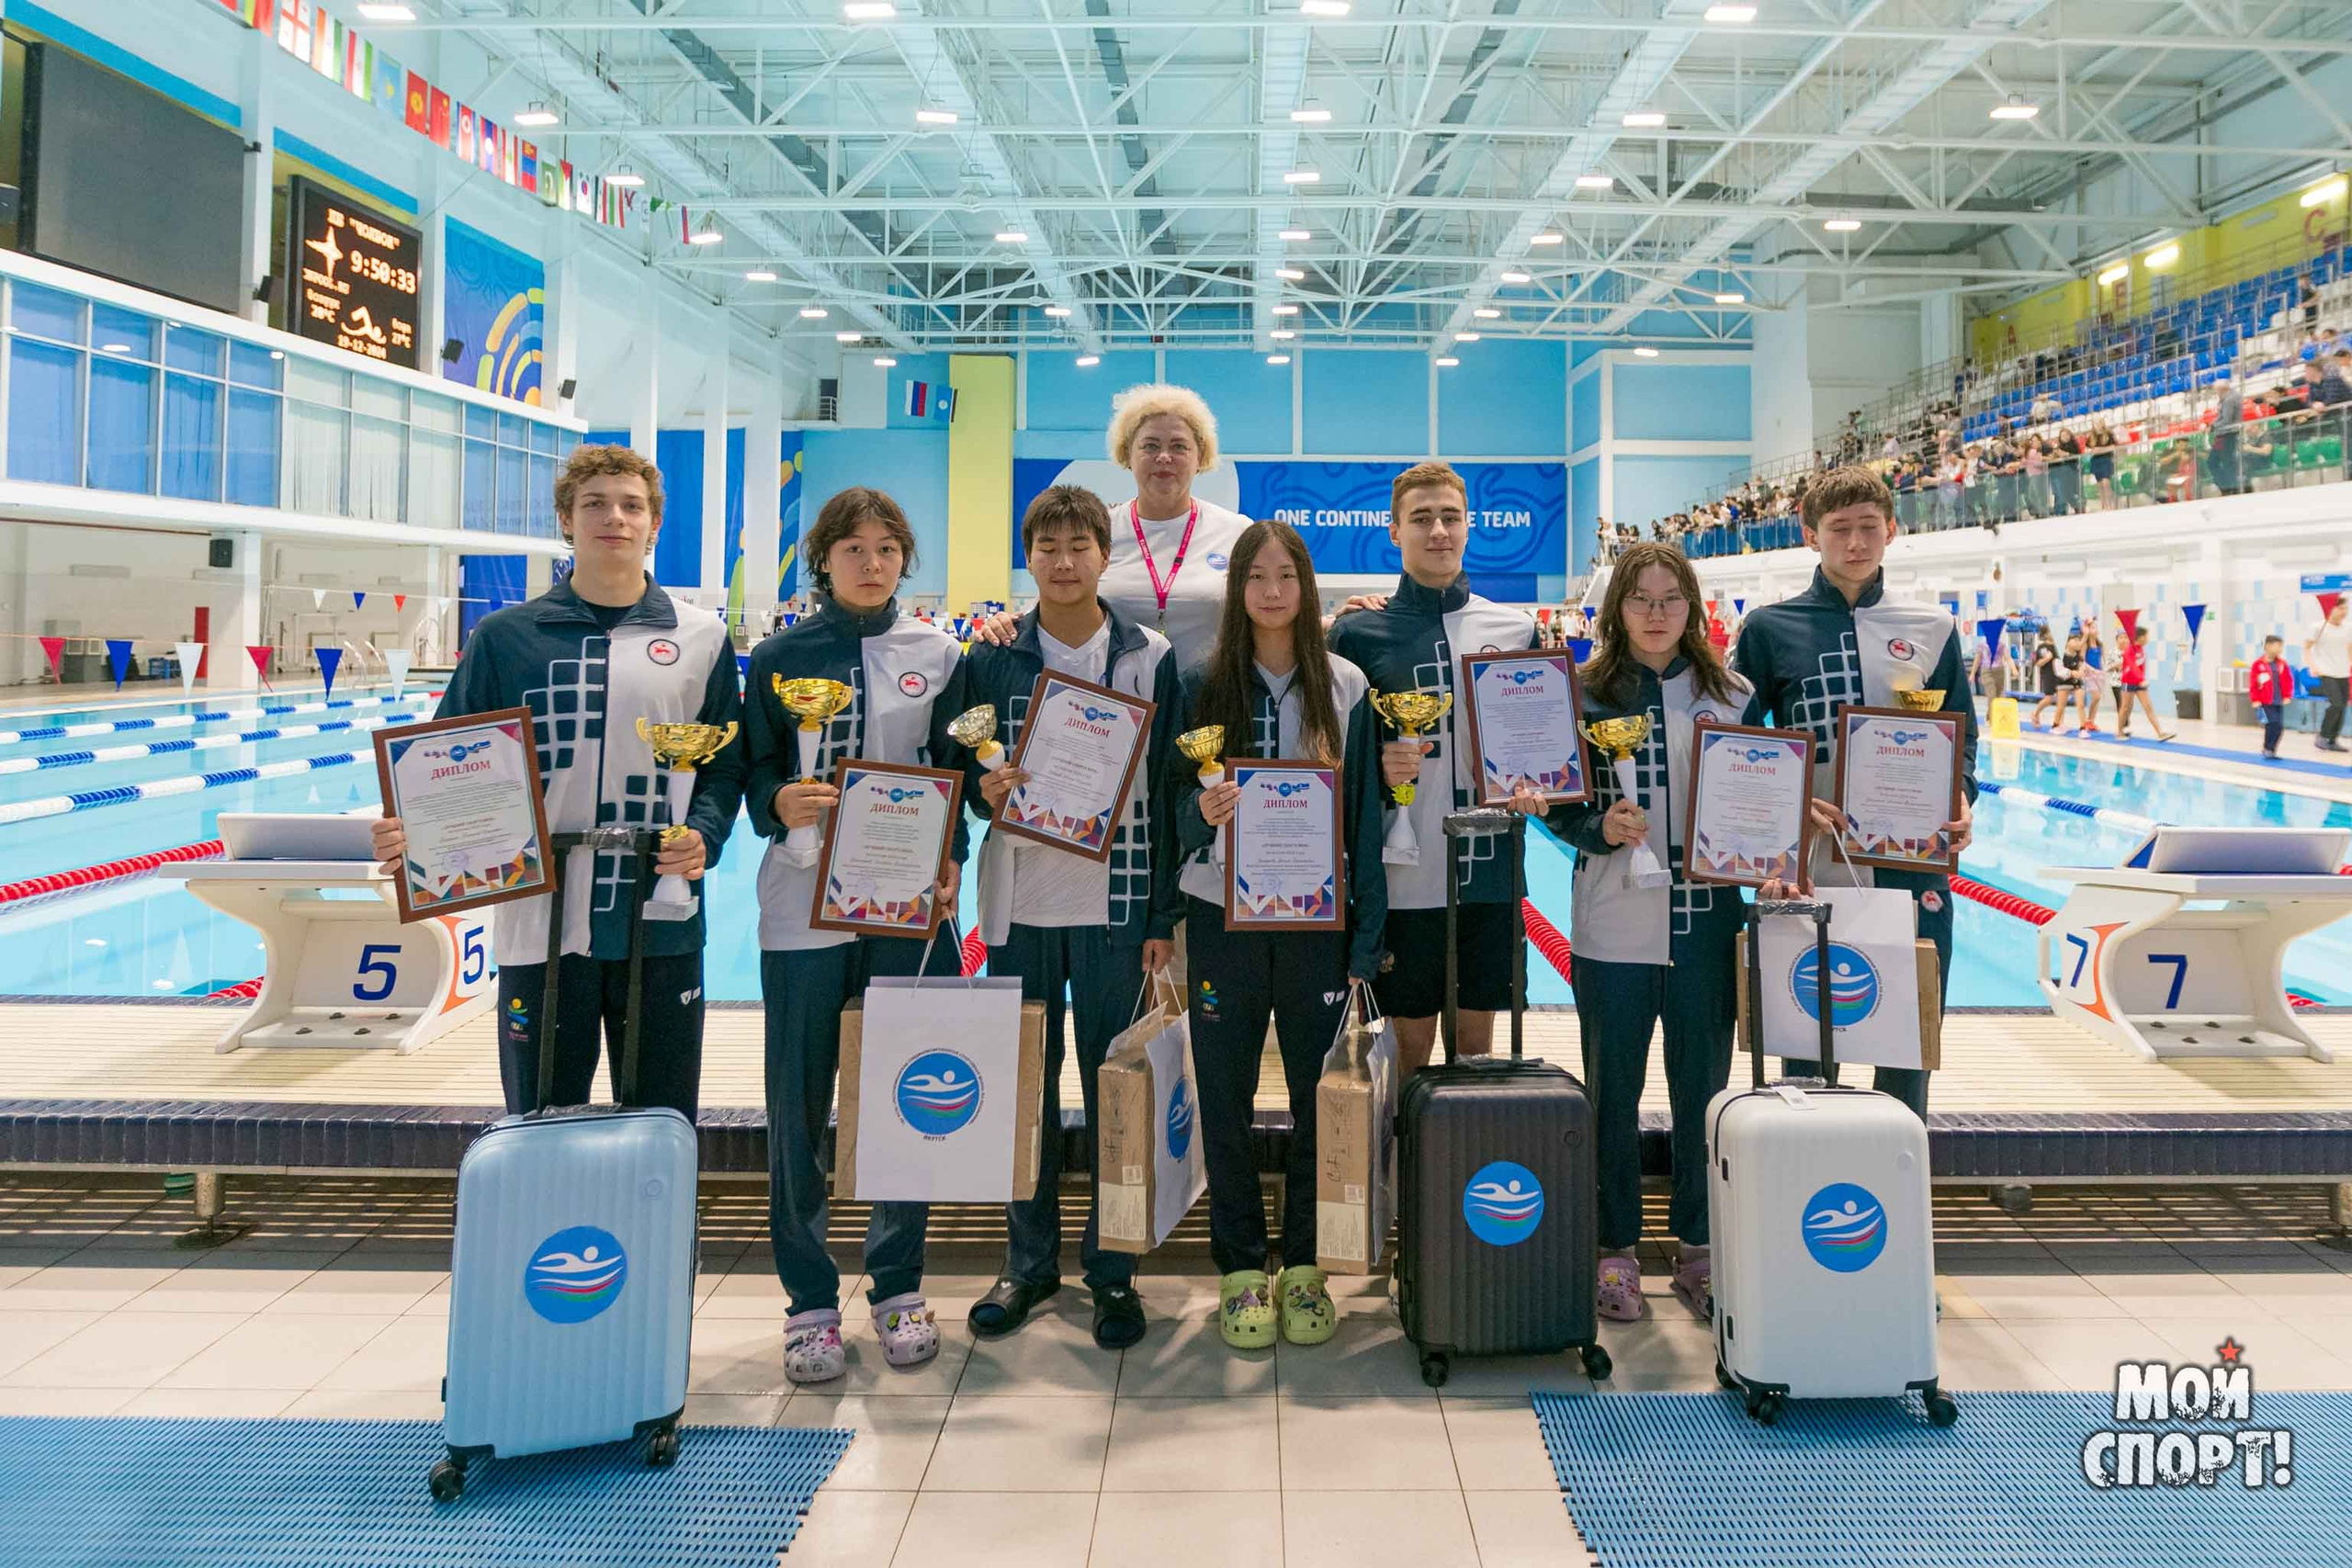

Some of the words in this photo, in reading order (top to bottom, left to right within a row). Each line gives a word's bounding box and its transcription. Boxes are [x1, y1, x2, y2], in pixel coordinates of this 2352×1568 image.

[2303, 209, 2326, 243] C
[350, 250, 416, 294] 9:50:33
[1274, 509, 1310, 526] ONE
[1316, 510, 1391, 528] CONTINE
[1482, 511, 1531, 528] TEAM
[1500, 685, 1544, 697] ДИПЛОМ
[1064, 715, 1113, 739] ДИПЛОМ
[1875, 745, 1925, 758] ДИПЛОМ
[430, 759, 492, 781] ДИПЛОМ
[1727, 762, 1776, 776] ДИПЛОМ
[869, 802, 920, 817] ДИПЛОМ
[1262, 798, 1308, 810] ДИПЛОМ
[462, 925, 486, 986] 5
[2066, 932, 2089, 988] 7
[353, 943, 402, 1001] 5
[2147, 953, 2188, 1010] 7
